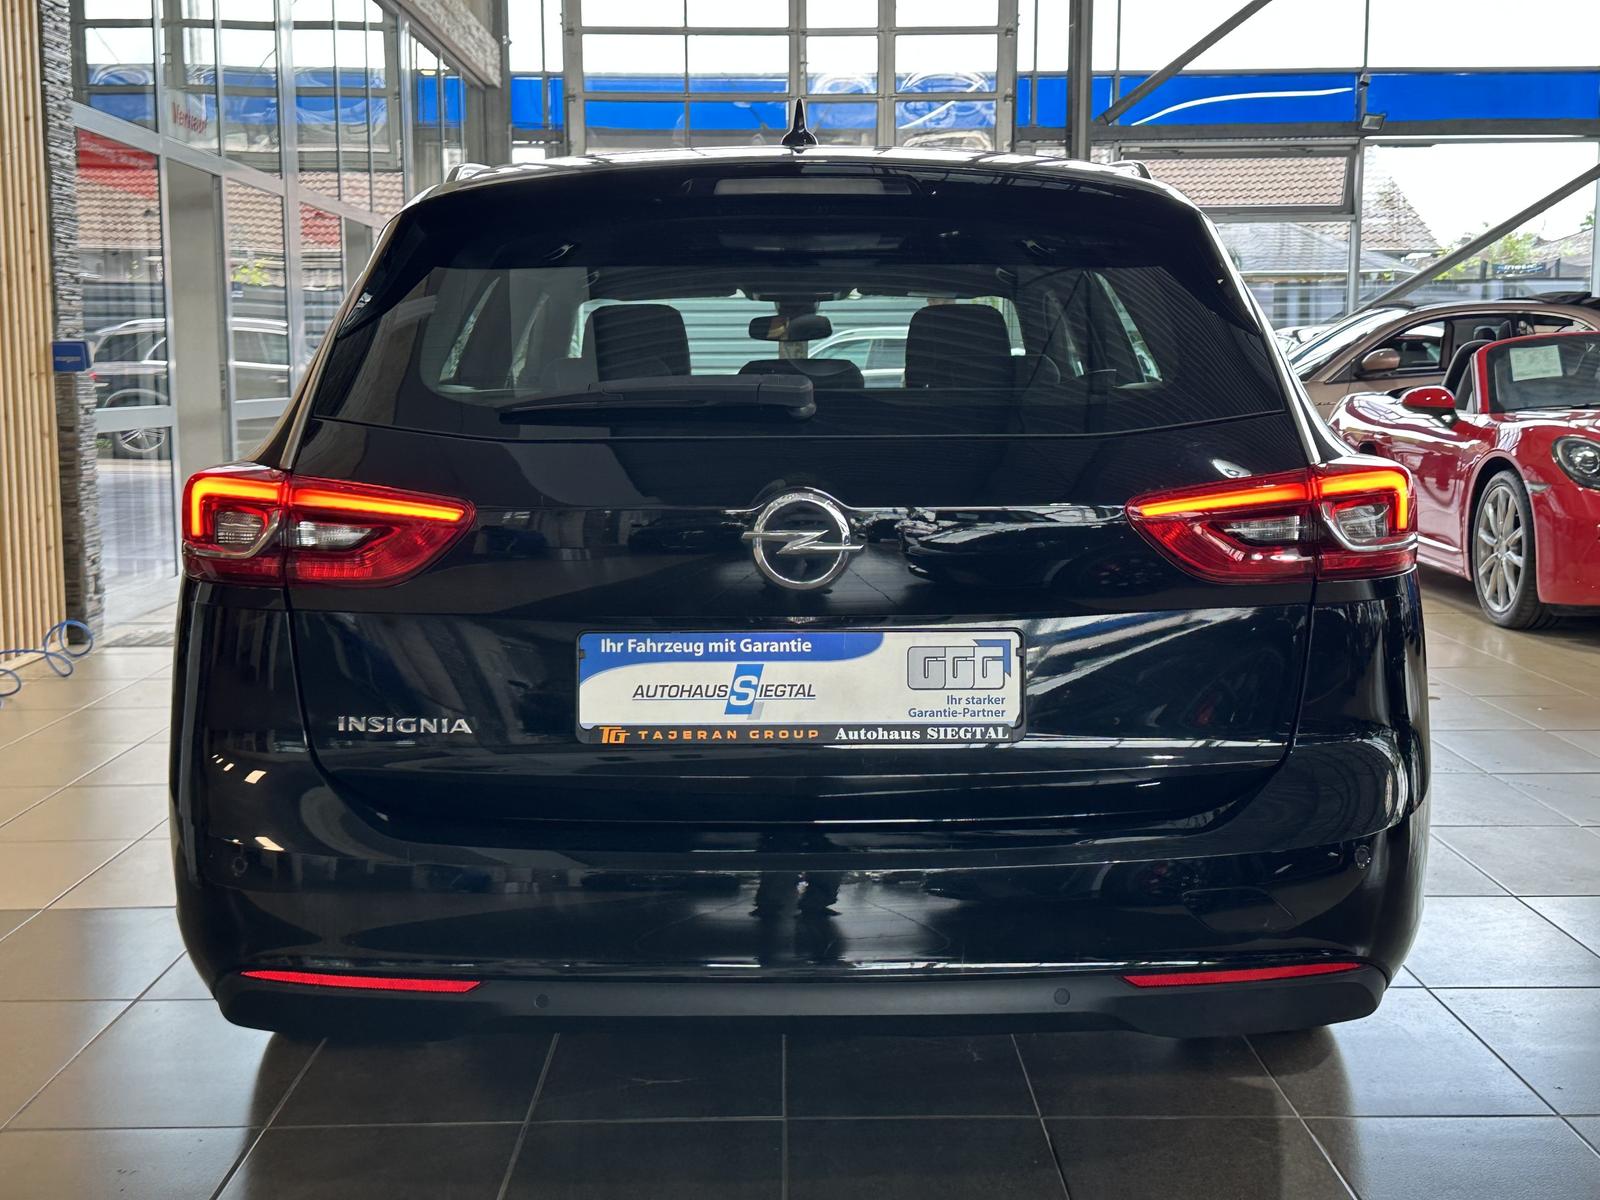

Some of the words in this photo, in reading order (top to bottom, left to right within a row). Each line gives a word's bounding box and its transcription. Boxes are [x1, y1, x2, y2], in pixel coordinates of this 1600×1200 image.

[601, 638, 623, 653] Ihr
[627, 638, 707, 656] Fahrzeug
[708, 638, 736, 653] mit
[740, 638, 812, 653] Garantie
[907, 645, 1005, 690] GGG
[632, 684, 729, 698] AUTOHAUS
[946, 695, 963, 705] Ihr
[965, 695, 1006, 705] starker
[908, 708, 1006, 718] Garantie-Partner
[337, 715, 473, 734] INSIGNIA
[638, 730, 737, 740] TAJERAN
[749, 730, 819, 740] GROUP
[835, 727, 921, 740] Autohaus
[926, 726, 1009, 740] SIEGTAL
